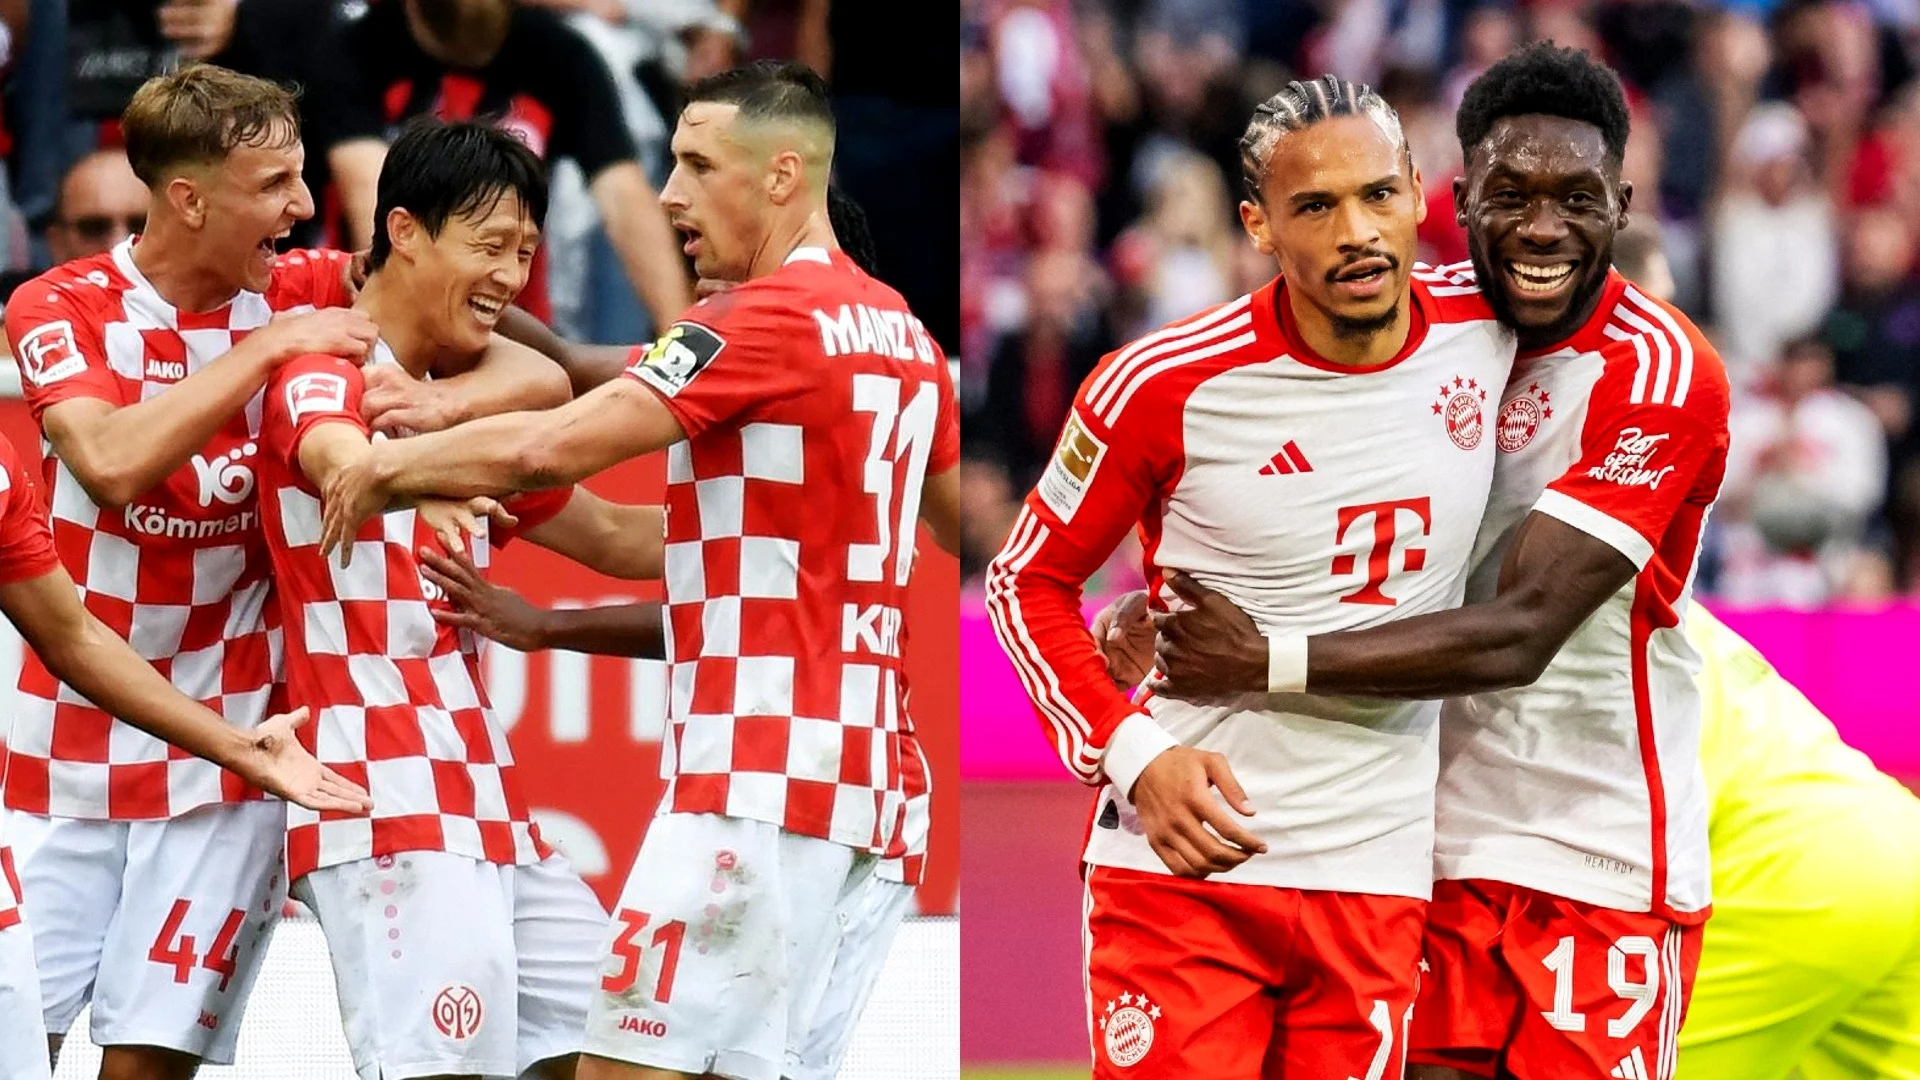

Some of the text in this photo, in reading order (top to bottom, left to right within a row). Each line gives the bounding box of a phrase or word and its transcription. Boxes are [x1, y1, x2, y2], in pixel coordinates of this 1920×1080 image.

[145, 359, 185, 379] JAKO
[847, 373, 938, 587] 31
[147, 898, 247, 993] 44
[600, 907, 688, 1004] 31
[1540, 935, 1660, 1039] 19
[618, 1015, 667, 1037] JAKO
[1110, 1039, 1148, 1062] MÜNCHEN
[1115, 1011, 1147, 1031] BAYERN
